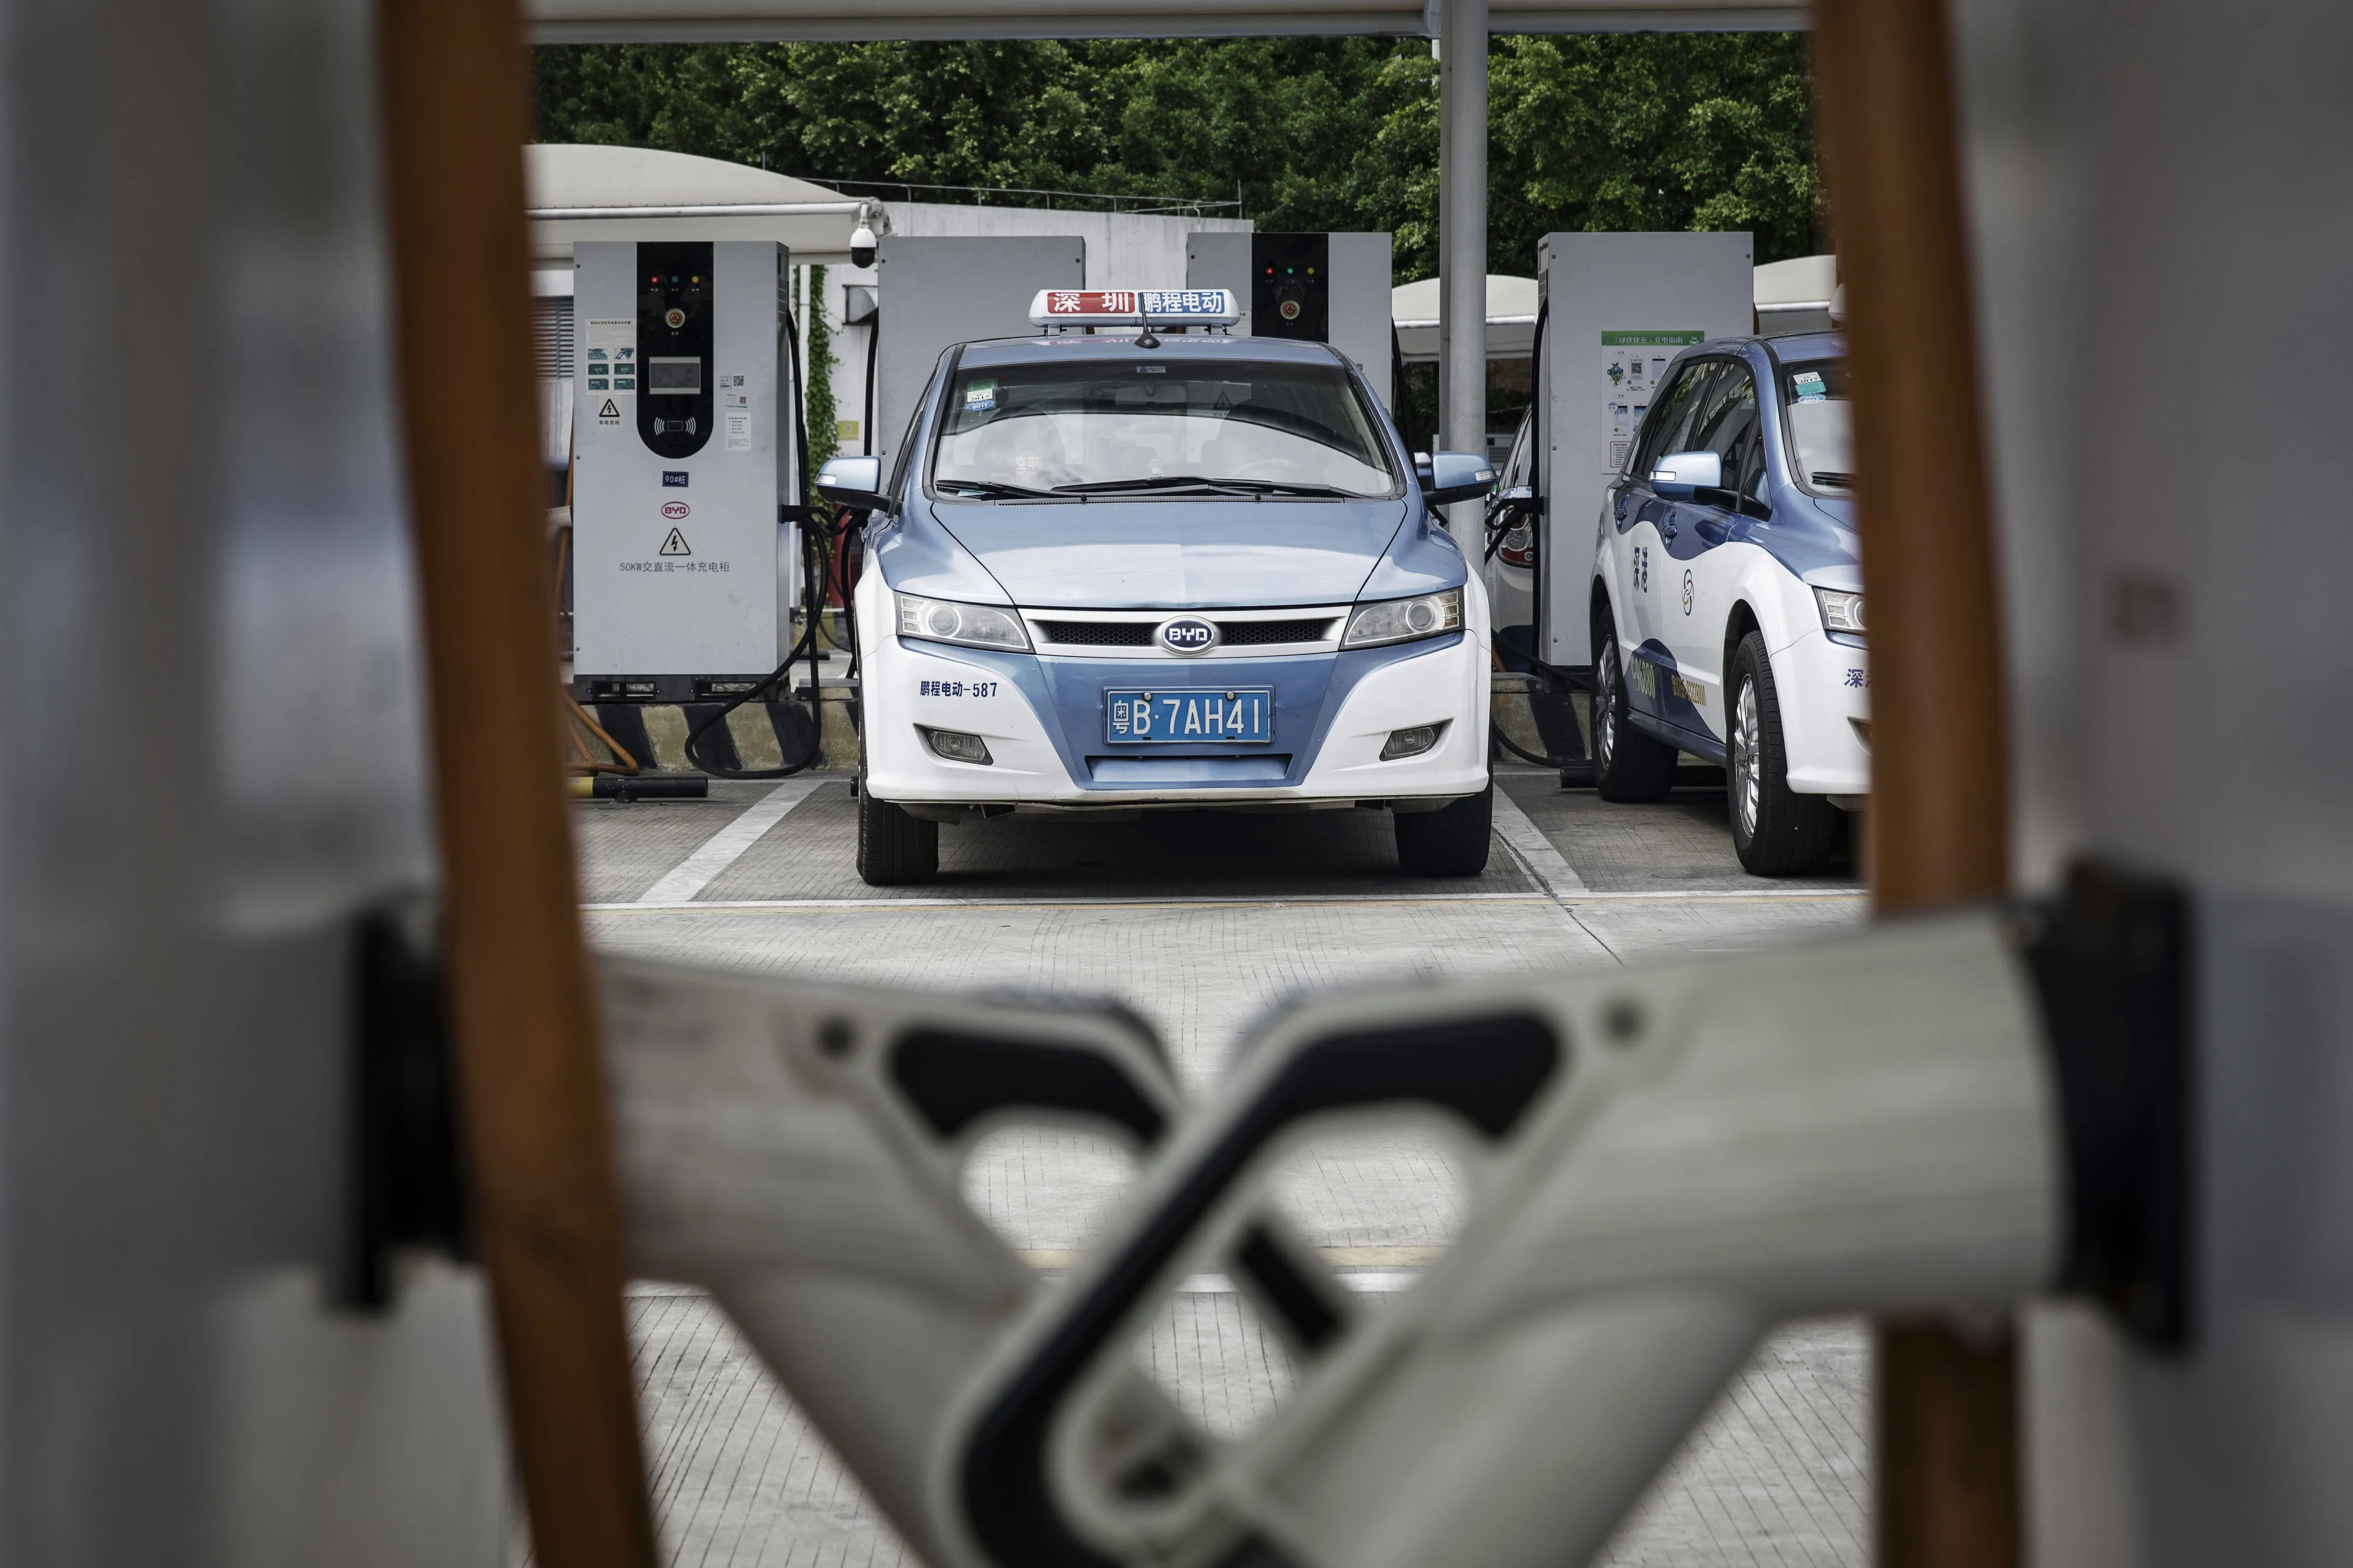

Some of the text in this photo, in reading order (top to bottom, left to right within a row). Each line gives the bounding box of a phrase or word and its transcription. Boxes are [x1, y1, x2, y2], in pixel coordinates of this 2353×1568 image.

[1143, 292, 1222, 313] 鹏程电动
[1015, 455, 1039, 471] 空车
[665, 506, 686, 515] BYD
[619, 561, 730, 572] 50KW交直流一体充电柜
[1168, 628, 1208, 641] BYD
[1635, 657, 1655, 699] 96880
[1844, 668, 1870, 688] 深
[919, 680, 997, 698] 鹏程电动-587
